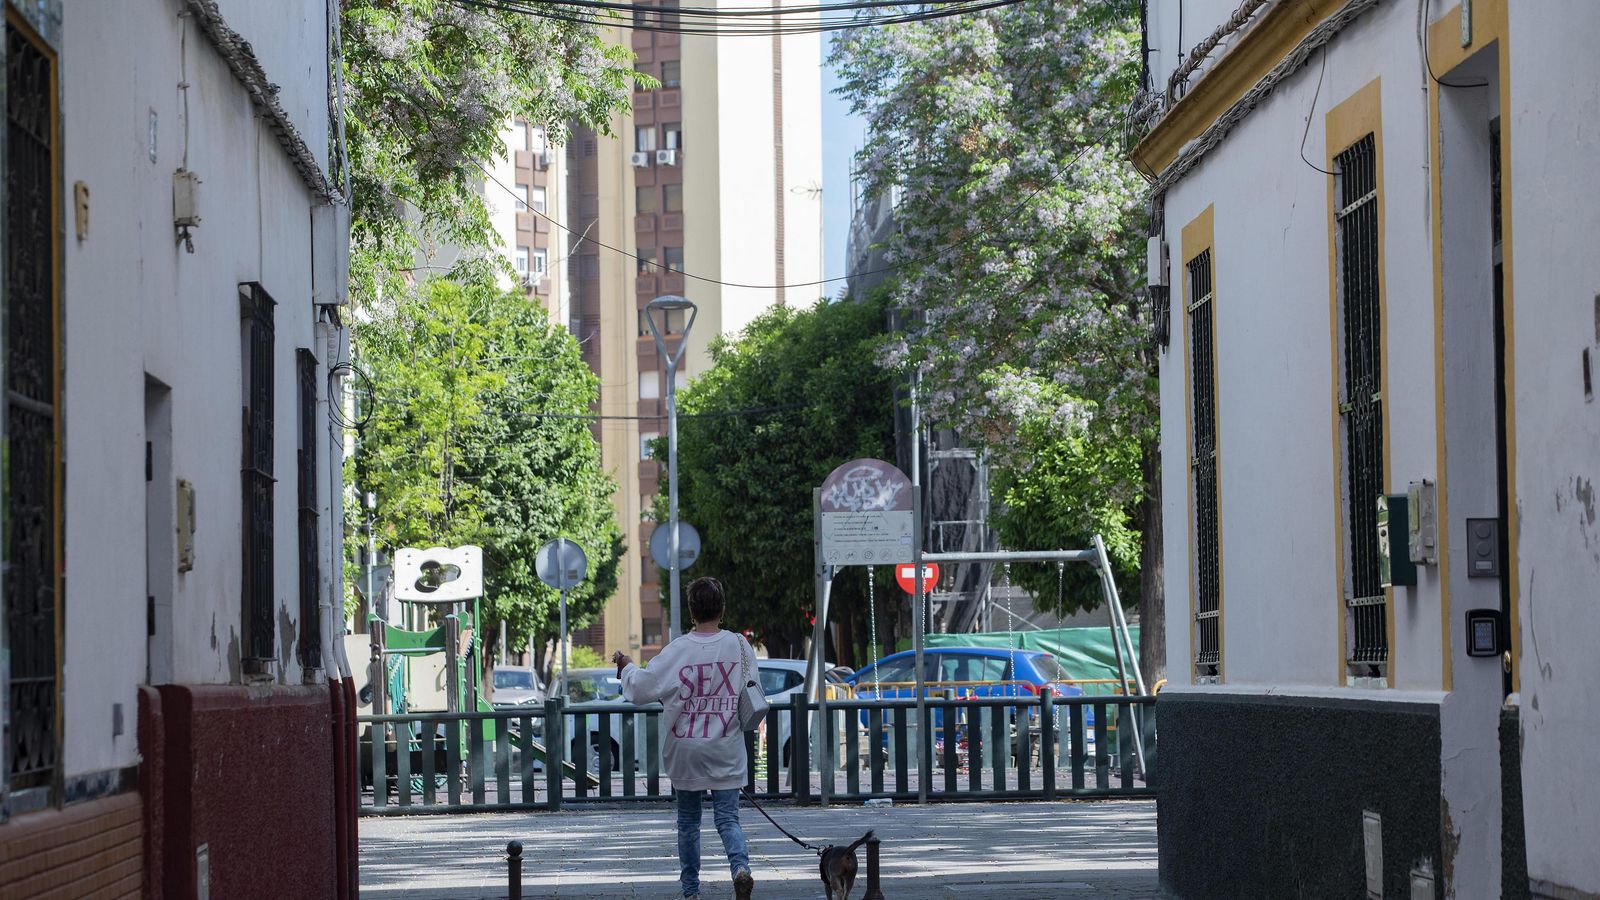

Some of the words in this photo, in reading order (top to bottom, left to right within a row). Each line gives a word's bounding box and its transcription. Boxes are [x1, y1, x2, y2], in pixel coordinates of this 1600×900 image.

[678, 661, 739, 700] SEX
[709, 697, 738, 711] THE
[671, 711, 737, 739] CITY
